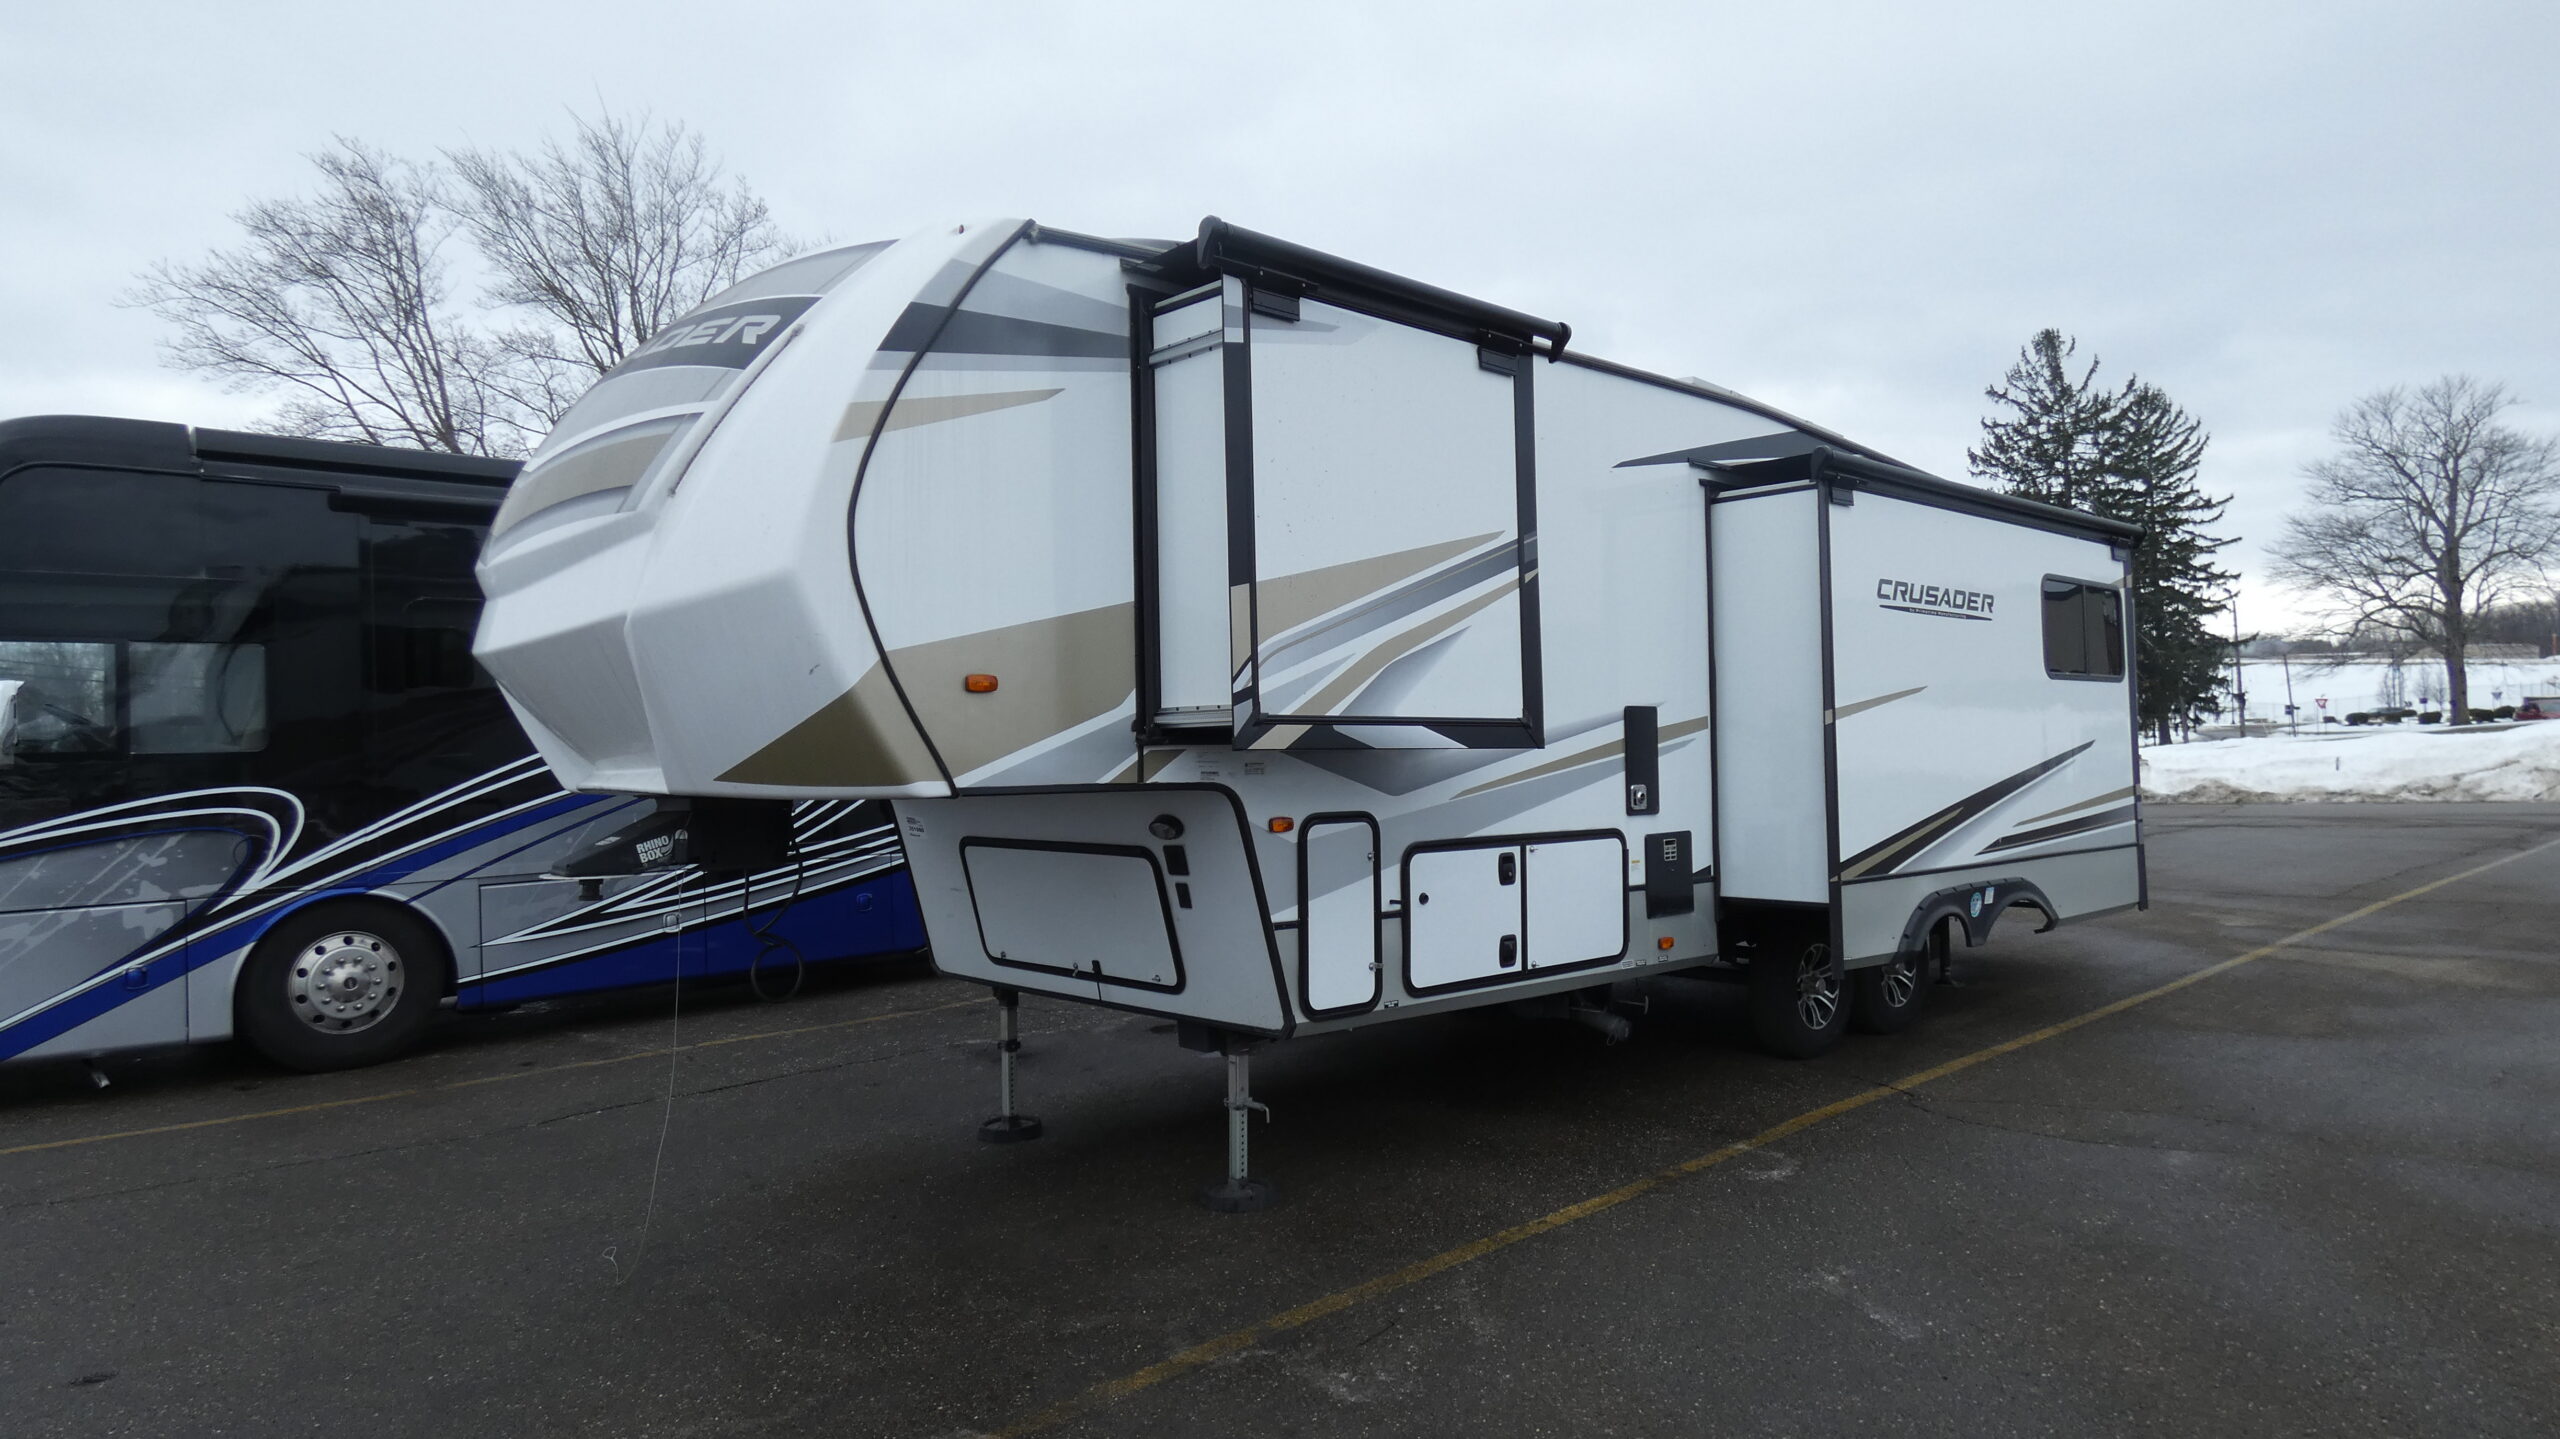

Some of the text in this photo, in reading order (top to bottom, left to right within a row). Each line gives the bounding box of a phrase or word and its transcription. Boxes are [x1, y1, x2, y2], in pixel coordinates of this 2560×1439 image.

[634, 314, 781, 358] DER
[1876, 578, 1995, 614] CRUSADER
[636, 835, 669, 854] RHINO
[639, 848, 663, 864] BOX
